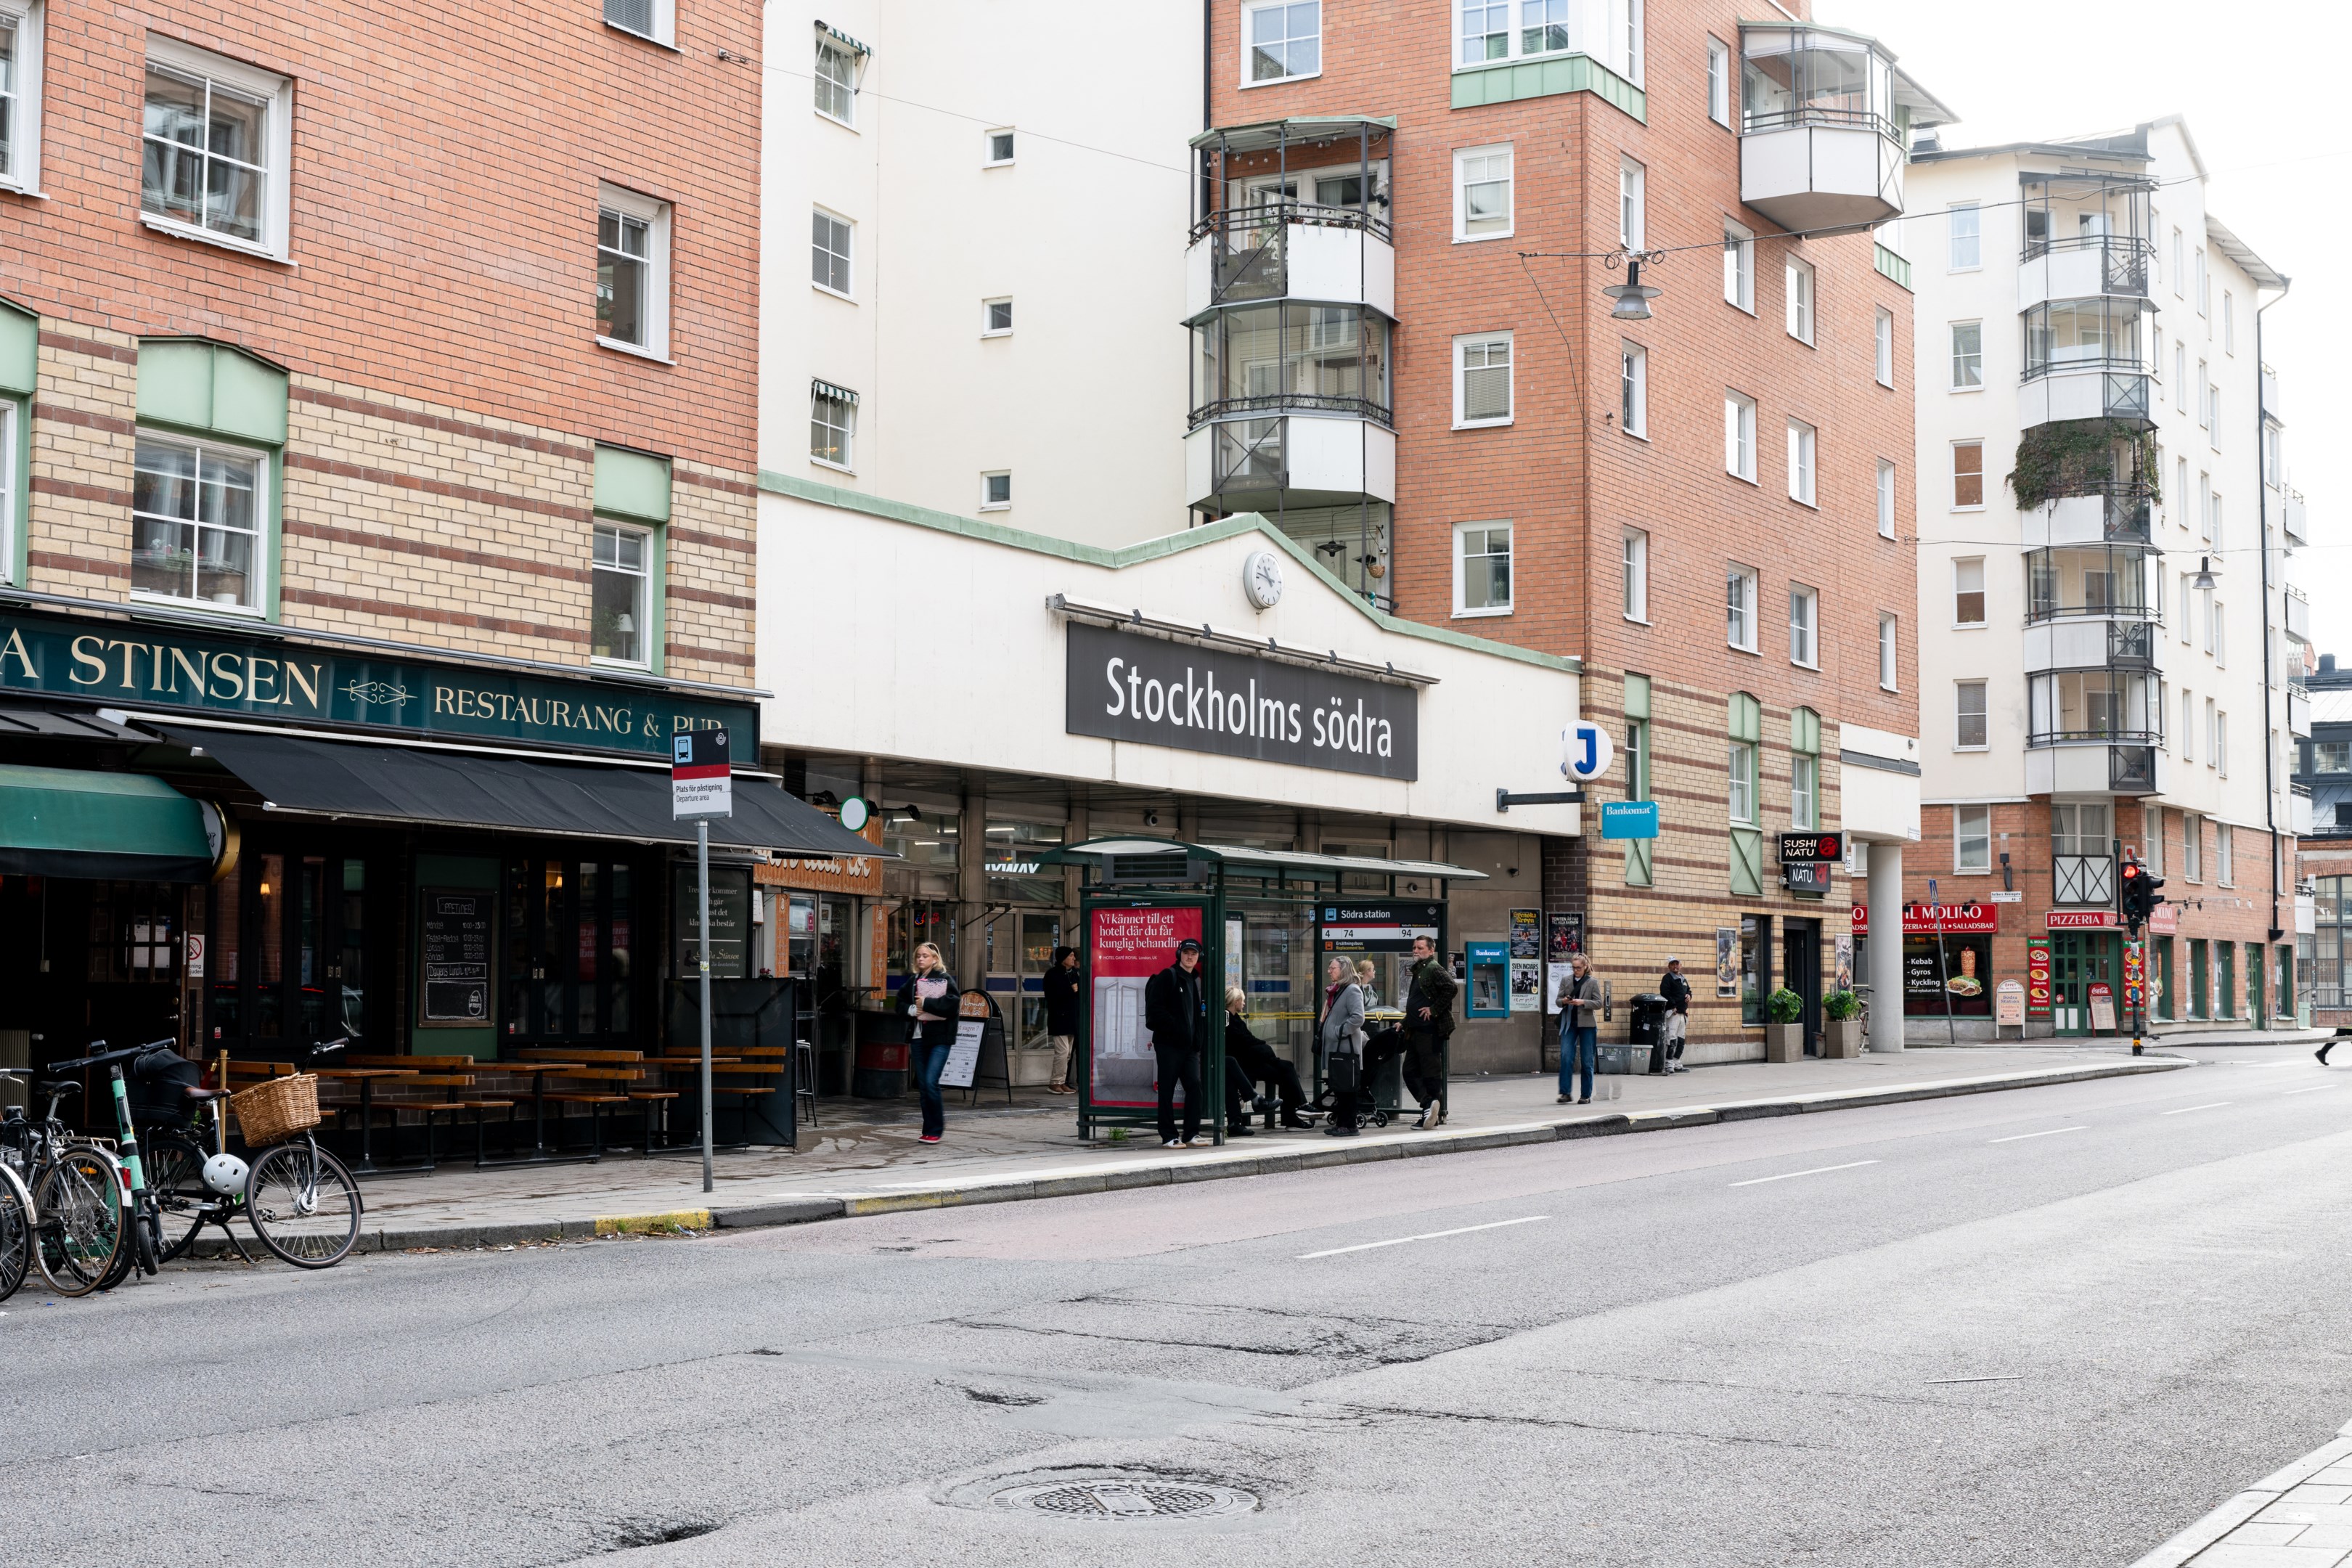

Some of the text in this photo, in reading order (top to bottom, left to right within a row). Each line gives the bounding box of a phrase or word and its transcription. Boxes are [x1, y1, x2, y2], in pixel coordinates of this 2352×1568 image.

[69, 635, 322, 709] STINSEN
[436, 687, 632, 734] RESTAURANG
[643, 714, 661, 737] &
[1106, 657, 1392, 757] Stockholms södra
[1575, 728, 1597, 775] J
[698, 784, 722, 793] påstigning
[1784, 839, 1817, 848] SUSHI
[1792, 869, 1813, 883] NATU
[714, 898, 723, 907] går
[1100, 913, 1174, 923] Vi känner till ett
[1906, 906, 1982, 919] IL MOLINO
[2050, 915, 2099, 925] PIZZERIA
[1100, 925, 1173, 936] hotell där du får
[1099, 937, 1182, 951] kunglig behandlin
[716, 949, 739, 960] Stinsen
